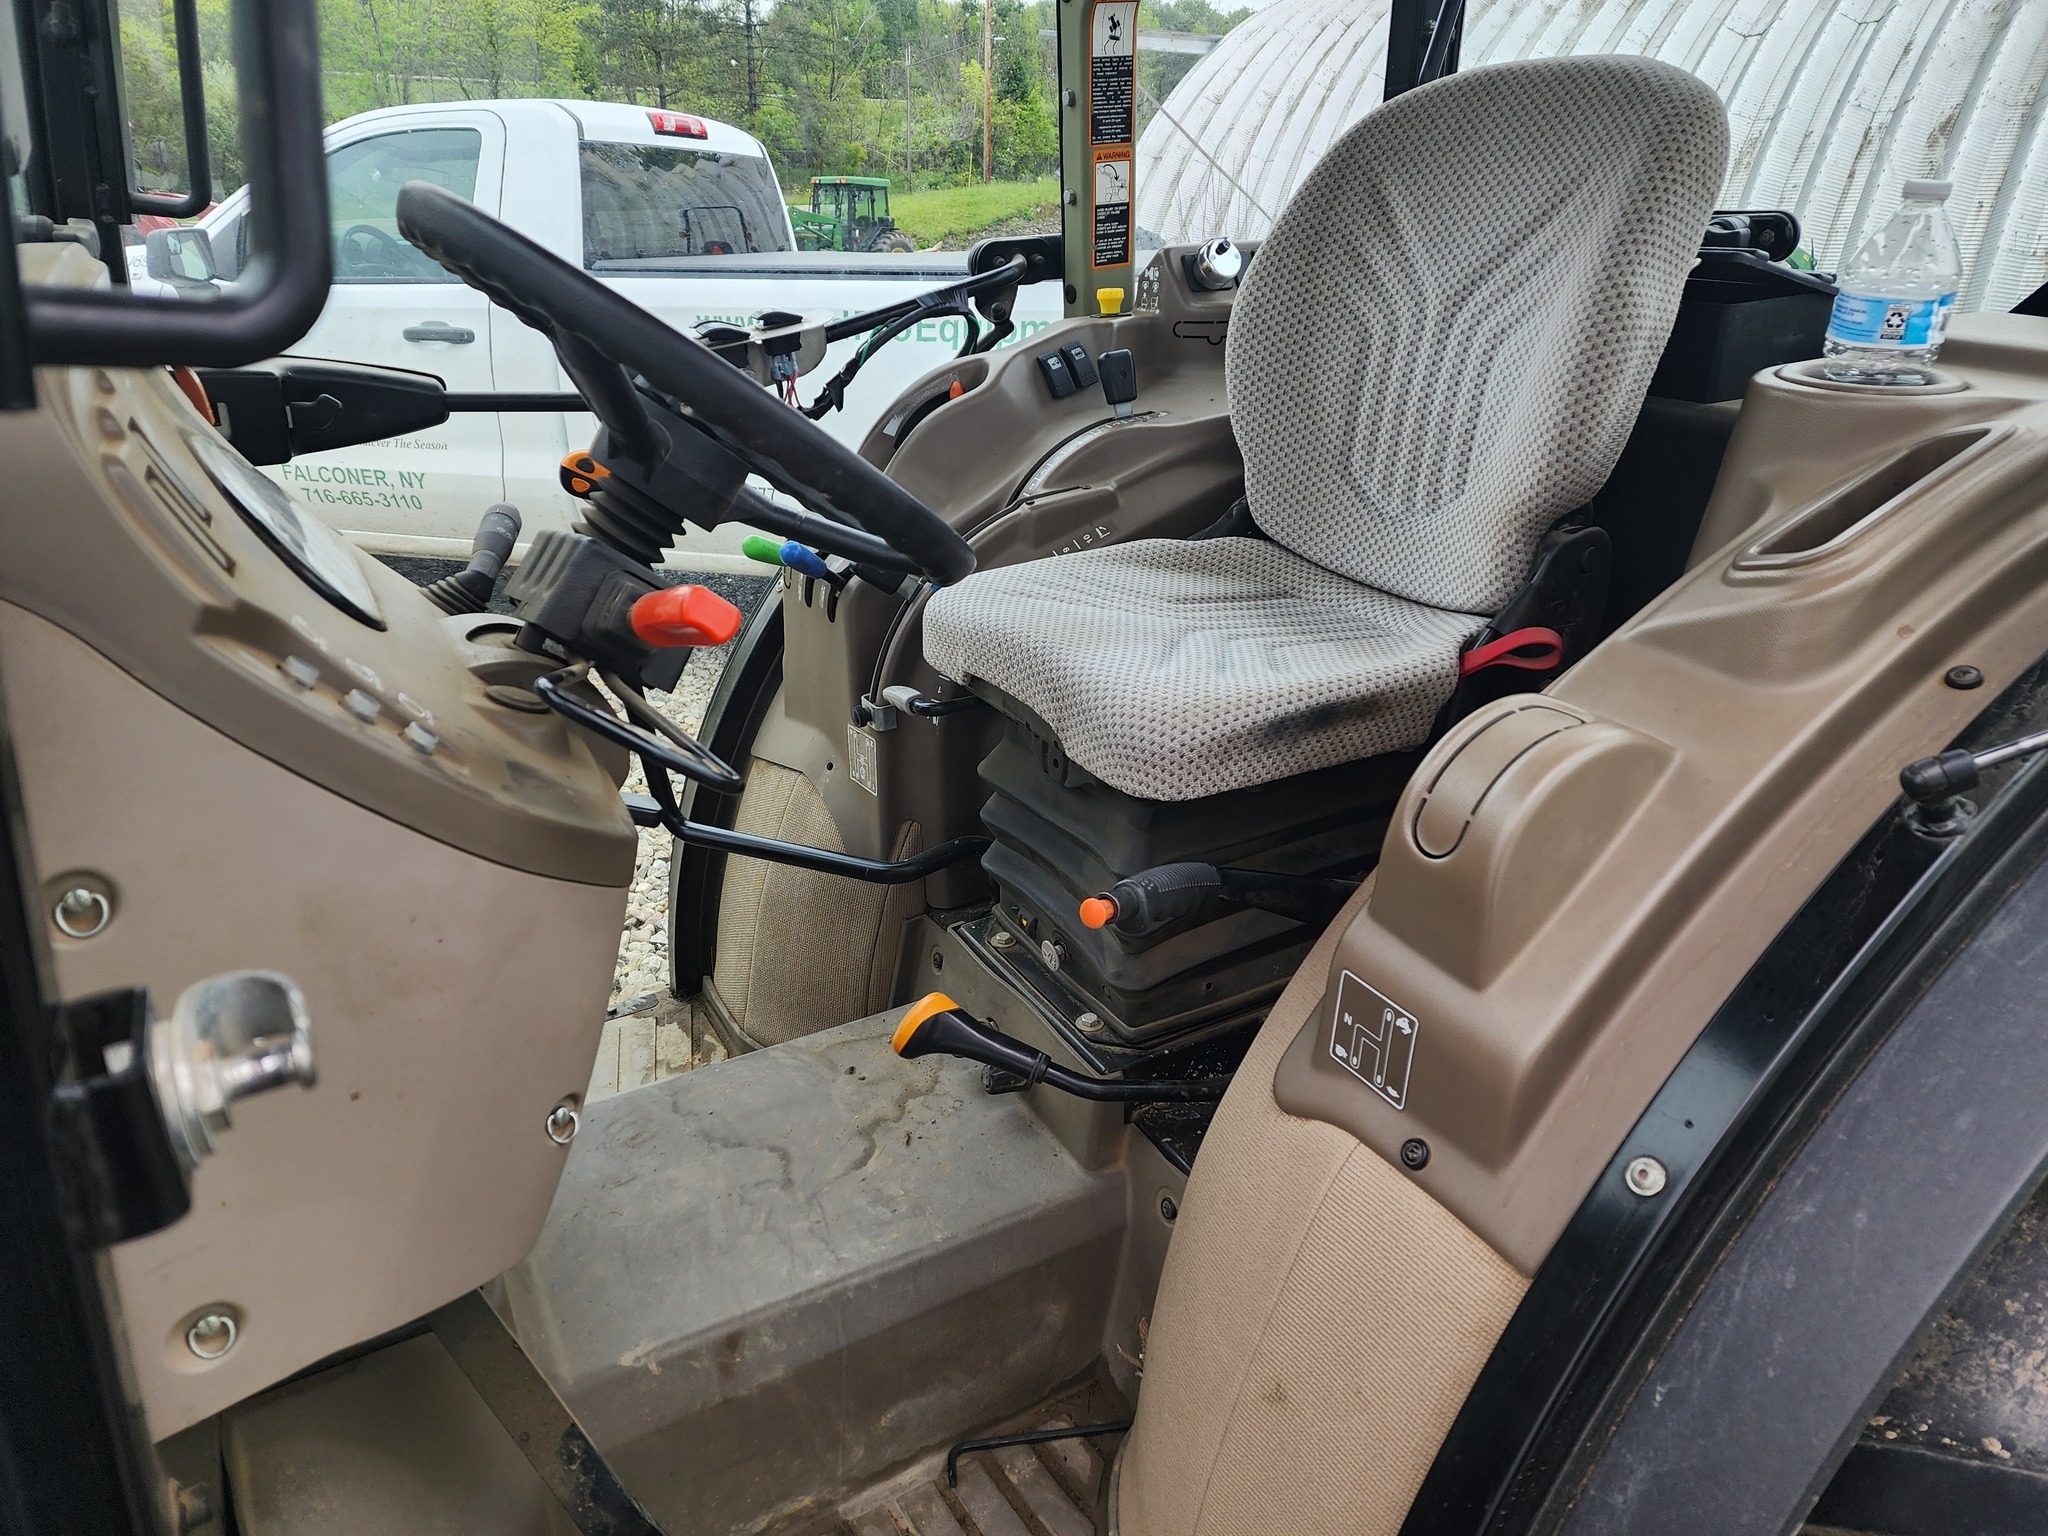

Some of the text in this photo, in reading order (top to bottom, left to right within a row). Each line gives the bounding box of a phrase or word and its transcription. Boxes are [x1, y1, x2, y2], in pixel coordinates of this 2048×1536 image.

[1103, 150, 1130, 160] WARNING
[394, 438, 412, 449] The
[414, 439, 448, 451] Season
[282, 464, 425, 490] FALCONER, NY
[300, 487, 422, 510] 716-665-3110
[1344, 1012, 1353, 1026] N
